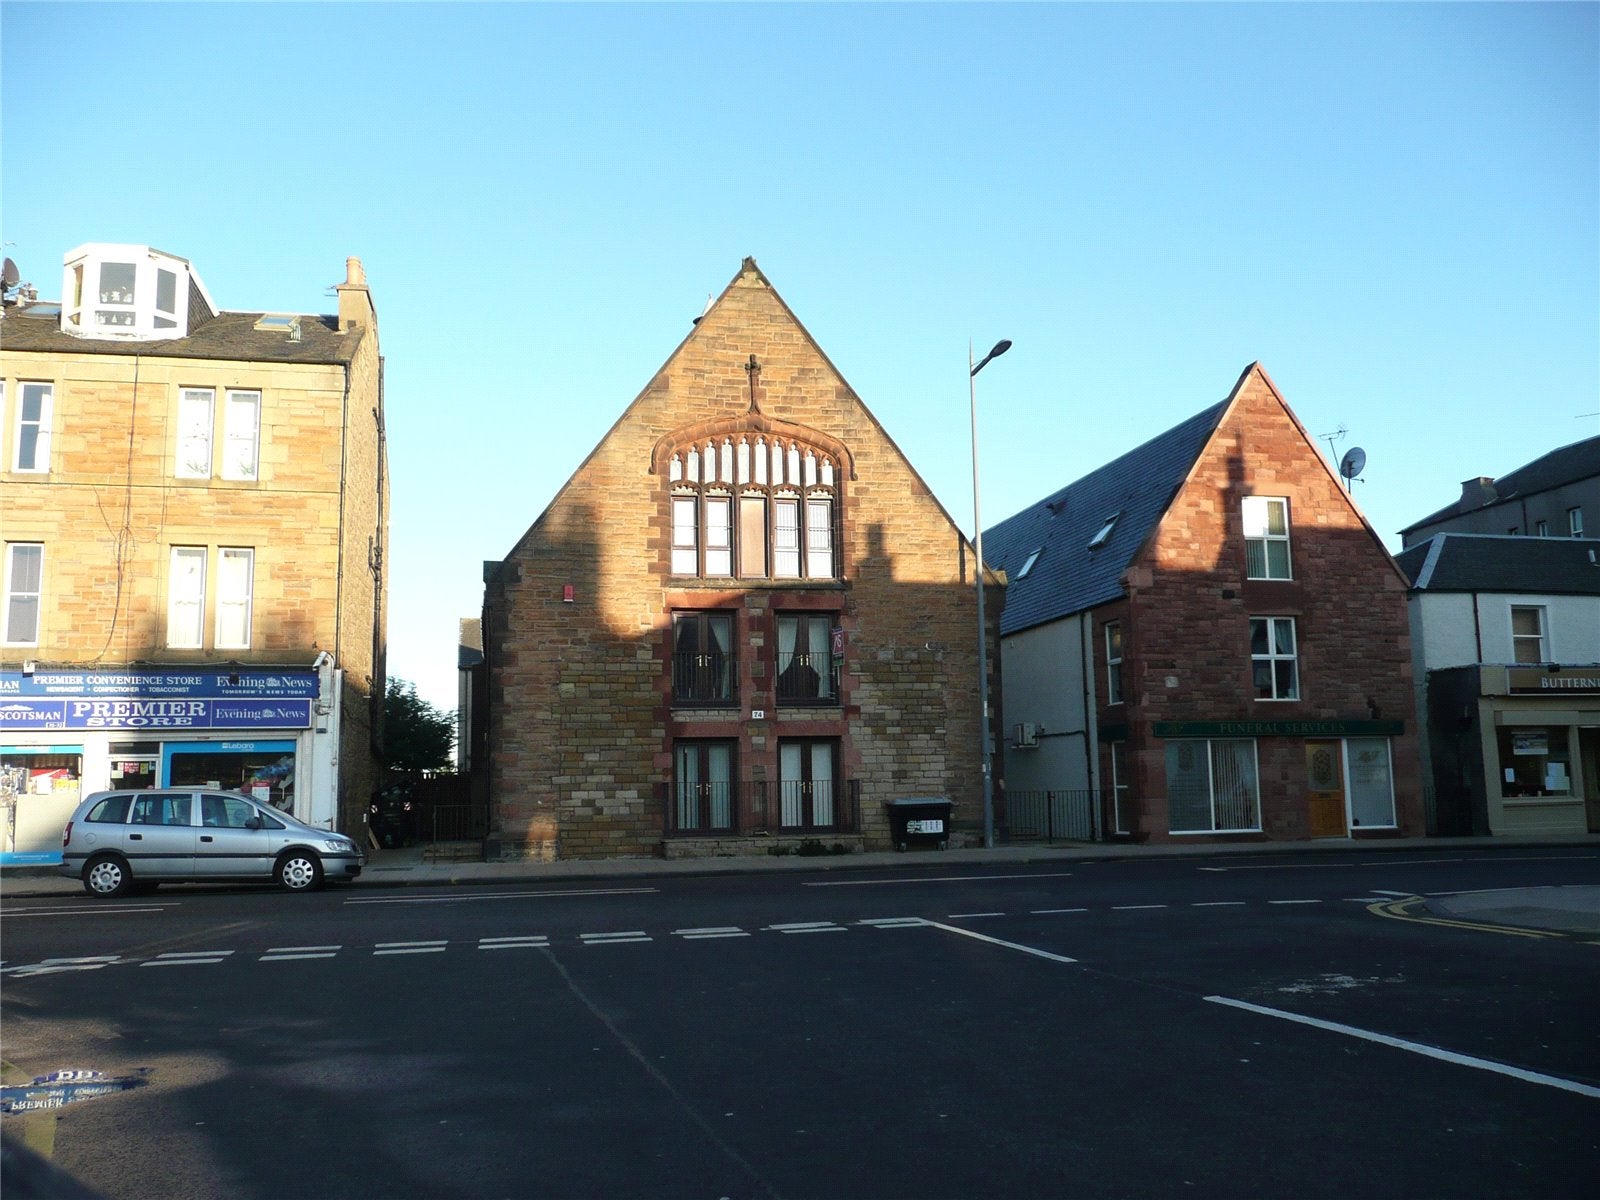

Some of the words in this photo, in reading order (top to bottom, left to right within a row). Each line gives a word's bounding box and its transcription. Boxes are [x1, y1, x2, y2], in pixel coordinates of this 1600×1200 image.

[33, 675, 84, 685] PREMIER
[86, 675, 163, 685] CONVENIENCE
[166, 676, 203, 685] STORE
[216, 676, 265, 689] Evning
[282, 677, 312, 688] News
[72, 701, 207, 717] PREMIER
[216, 708, 261, 720] Evening
[277, 708, 306, 718] News
[86, 717, 193, 727] STORE
[1219, 722, 1280, 734] FUNERAL
